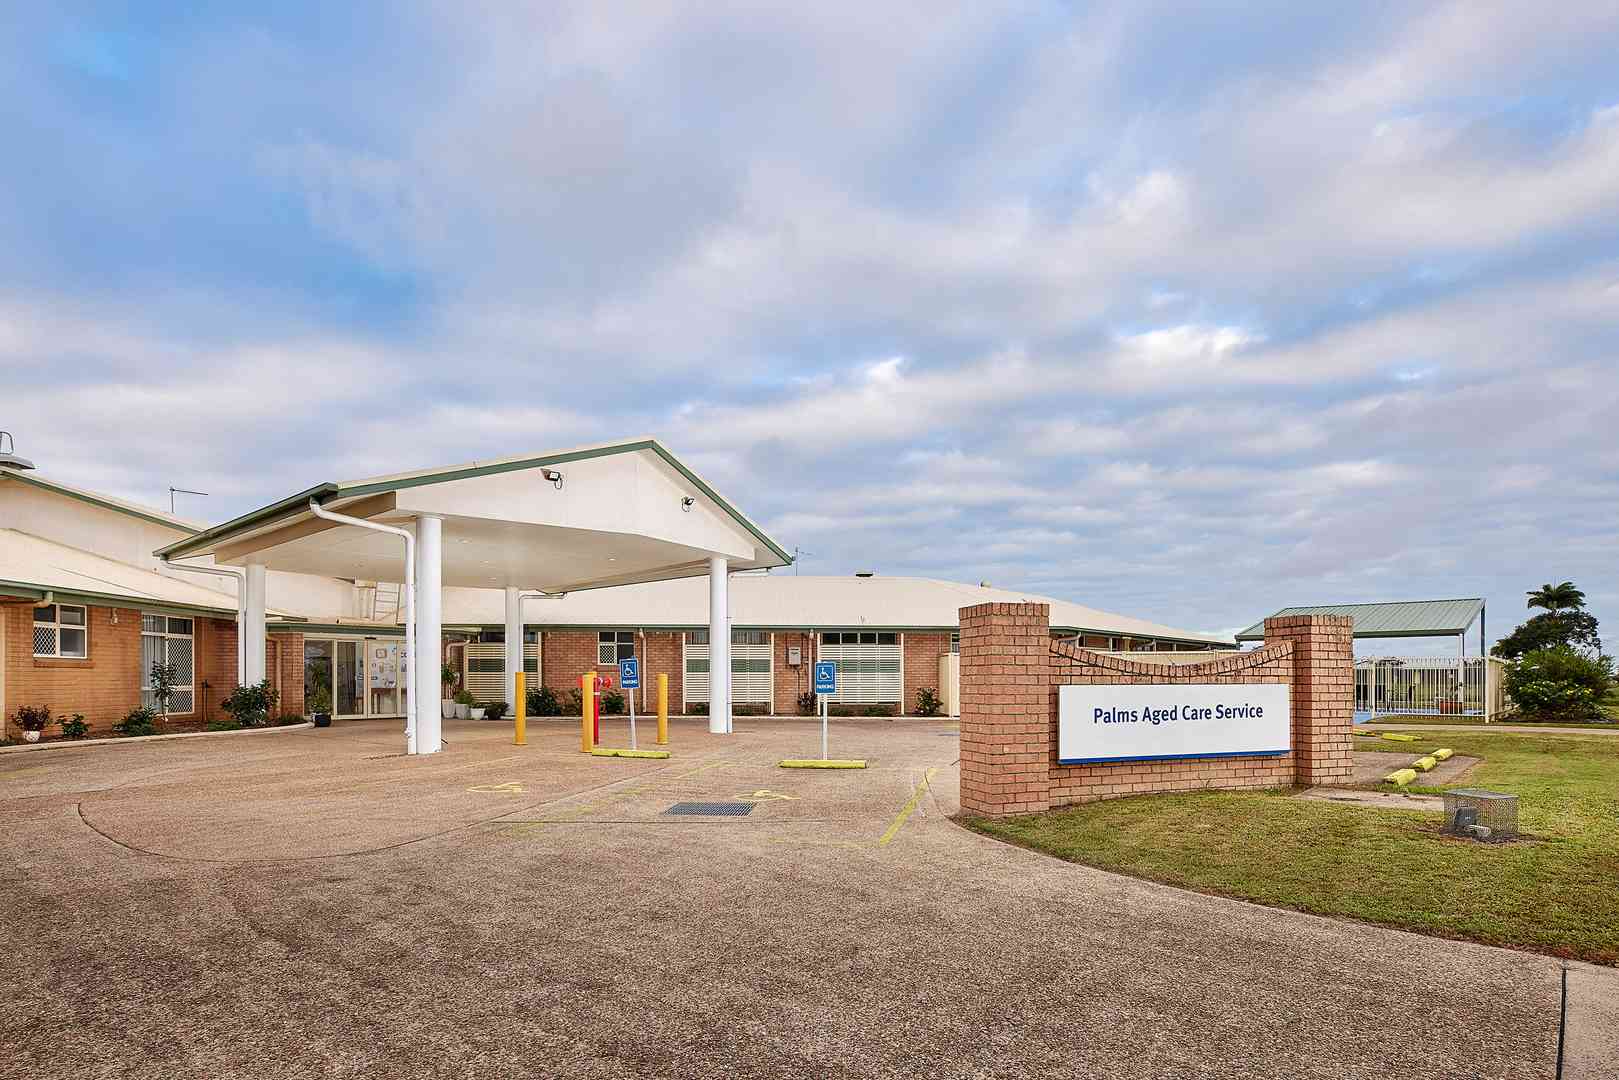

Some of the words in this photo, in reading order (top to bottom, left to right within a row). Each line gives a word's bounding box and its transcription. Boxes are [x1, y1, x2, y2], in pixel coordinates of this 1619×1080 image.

[1094, 707, 1138, 724] Palms
[1142, 705, 1178, 725] Aged
[1182, 705, 1212, 720] Care
[1215, 703, 1263, 719] Service
